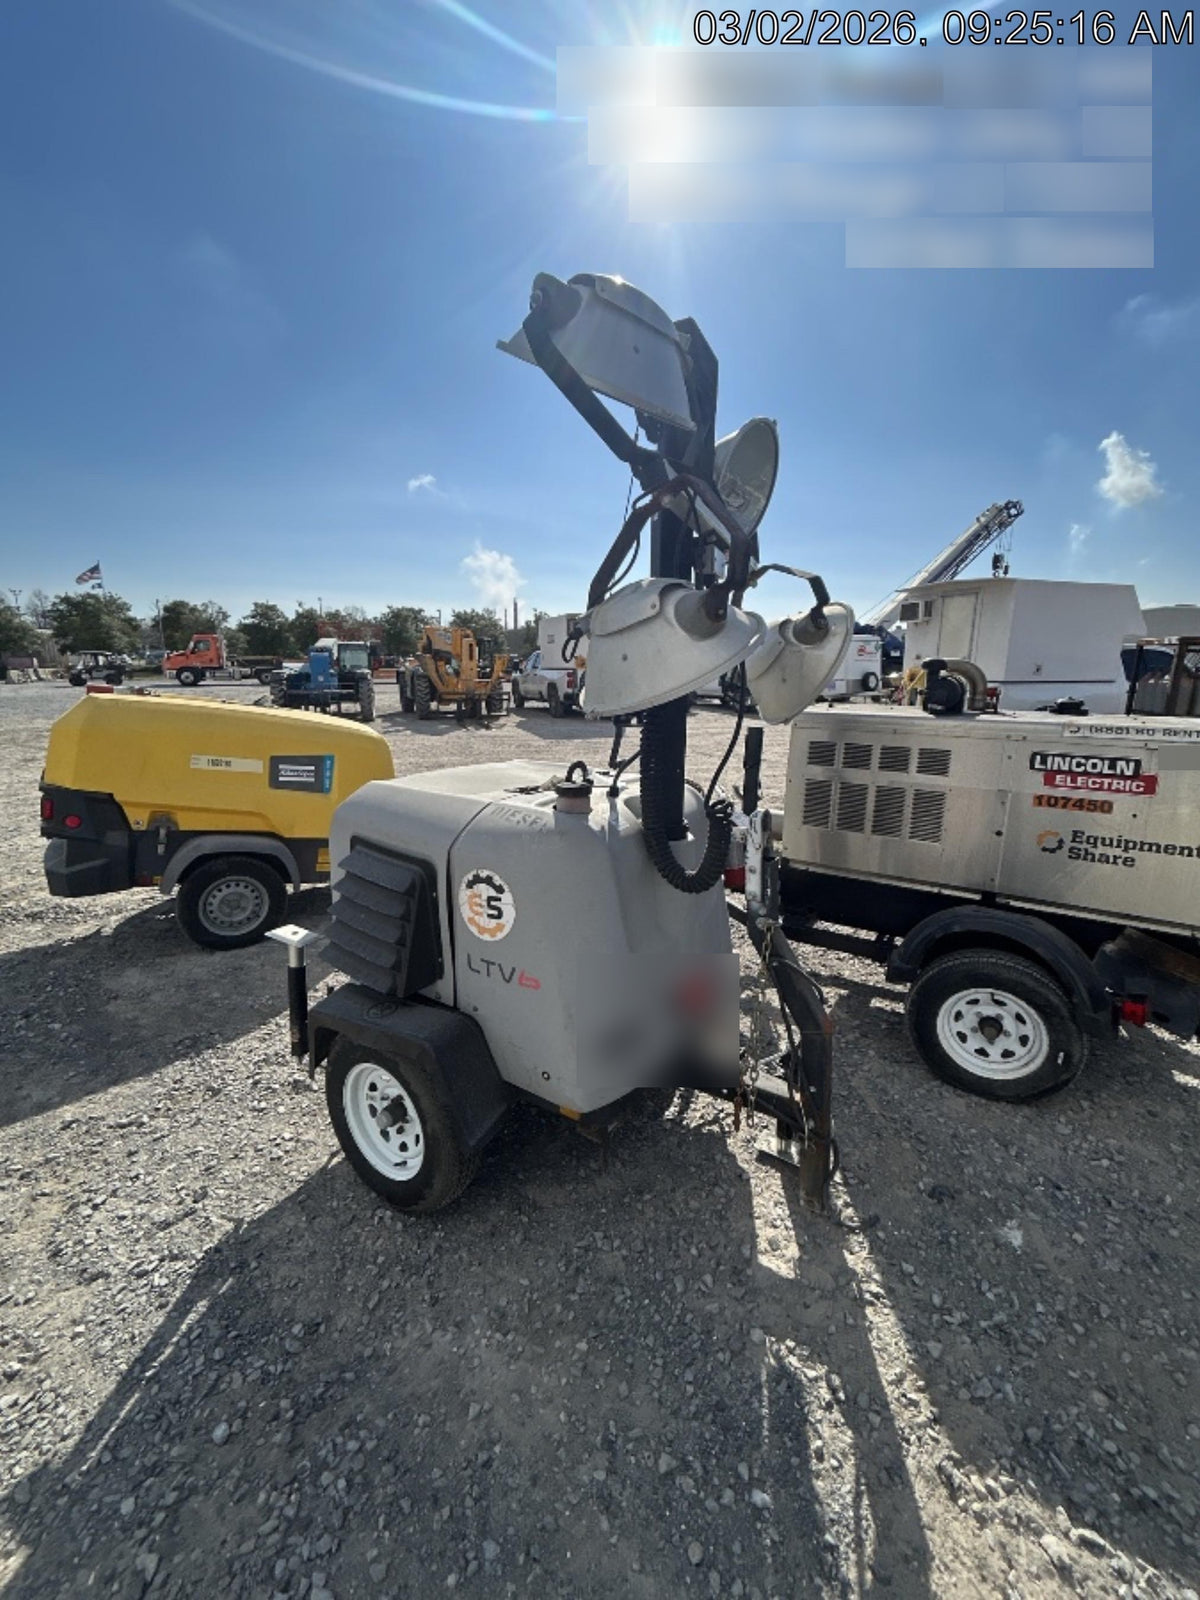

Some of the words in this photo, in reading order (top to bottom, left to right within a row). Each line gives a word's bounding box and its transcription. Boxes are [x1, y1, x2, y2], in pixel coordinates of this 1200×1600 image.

[1034, 755, 1136, 776] LINCOLN
[1054, 774, 1145, 792] ELECTRIC
[1035, 794, 1114, 814] 107450
[1067, 846, 1136, 868] Share
[467, 953, 541, 990] LTV6
